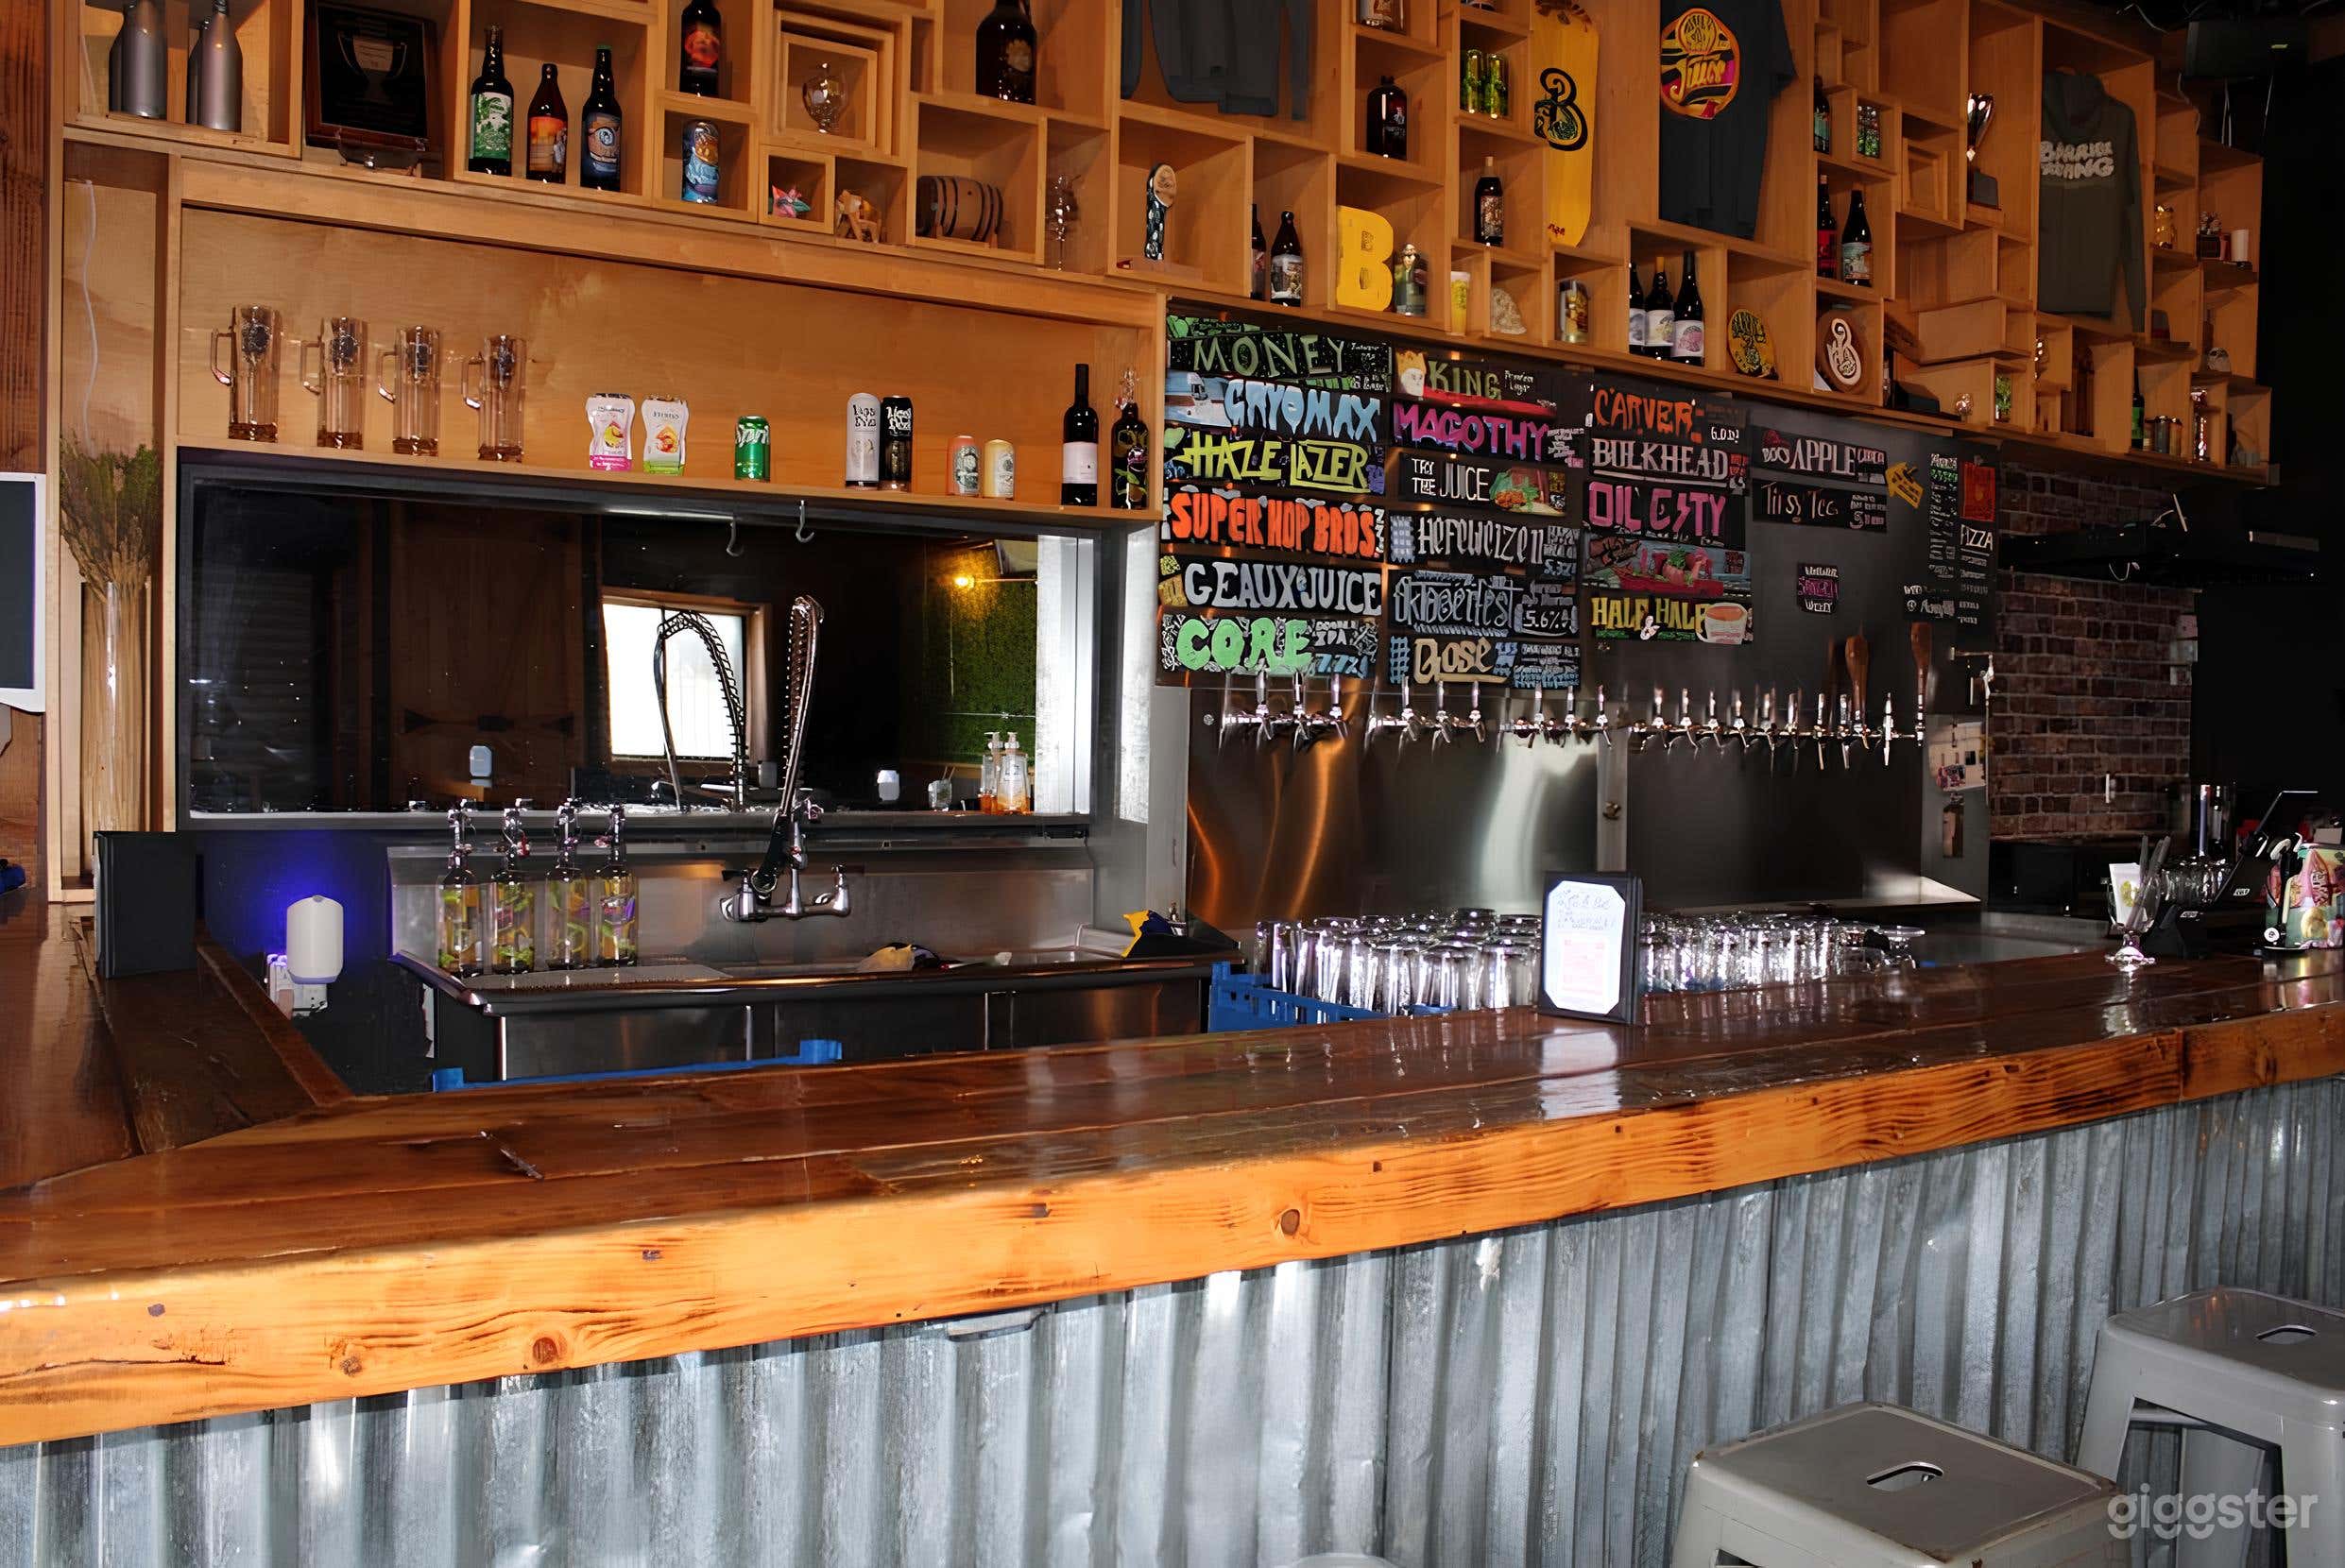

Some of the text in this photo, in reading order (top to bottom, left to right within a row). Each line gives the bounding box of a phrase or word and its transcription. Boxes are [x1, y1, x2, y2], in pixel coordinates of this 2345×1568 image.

[1193, 333, 1344, 378] MONEY
[1428, 360, 1502, 401] KING
[1394, 401, 1549, 461] MAGOTHY
[1594, 388, 1693, 437] CARVER
[1184, 431, 1282, 480] HAZE
[1291, 439, 1371, 493] LAZER
[1591, 438, 1728, 481] BULKHEAD
[1790, 438, 1856, 475] APPLE
[1439, 463, 1490, 501] JUICE
[1171, 492, 1376, 557] SUPER HOP BROS
[1589, 481, 1641, 533] OIL
[1960, 524, 1993, 552] PIZZA
[1184, 561, 1382, 616] GEAUX JUICE
[1591, 597, 1650, 632] HALF
[1176, 617, 1314, 672] CORE
